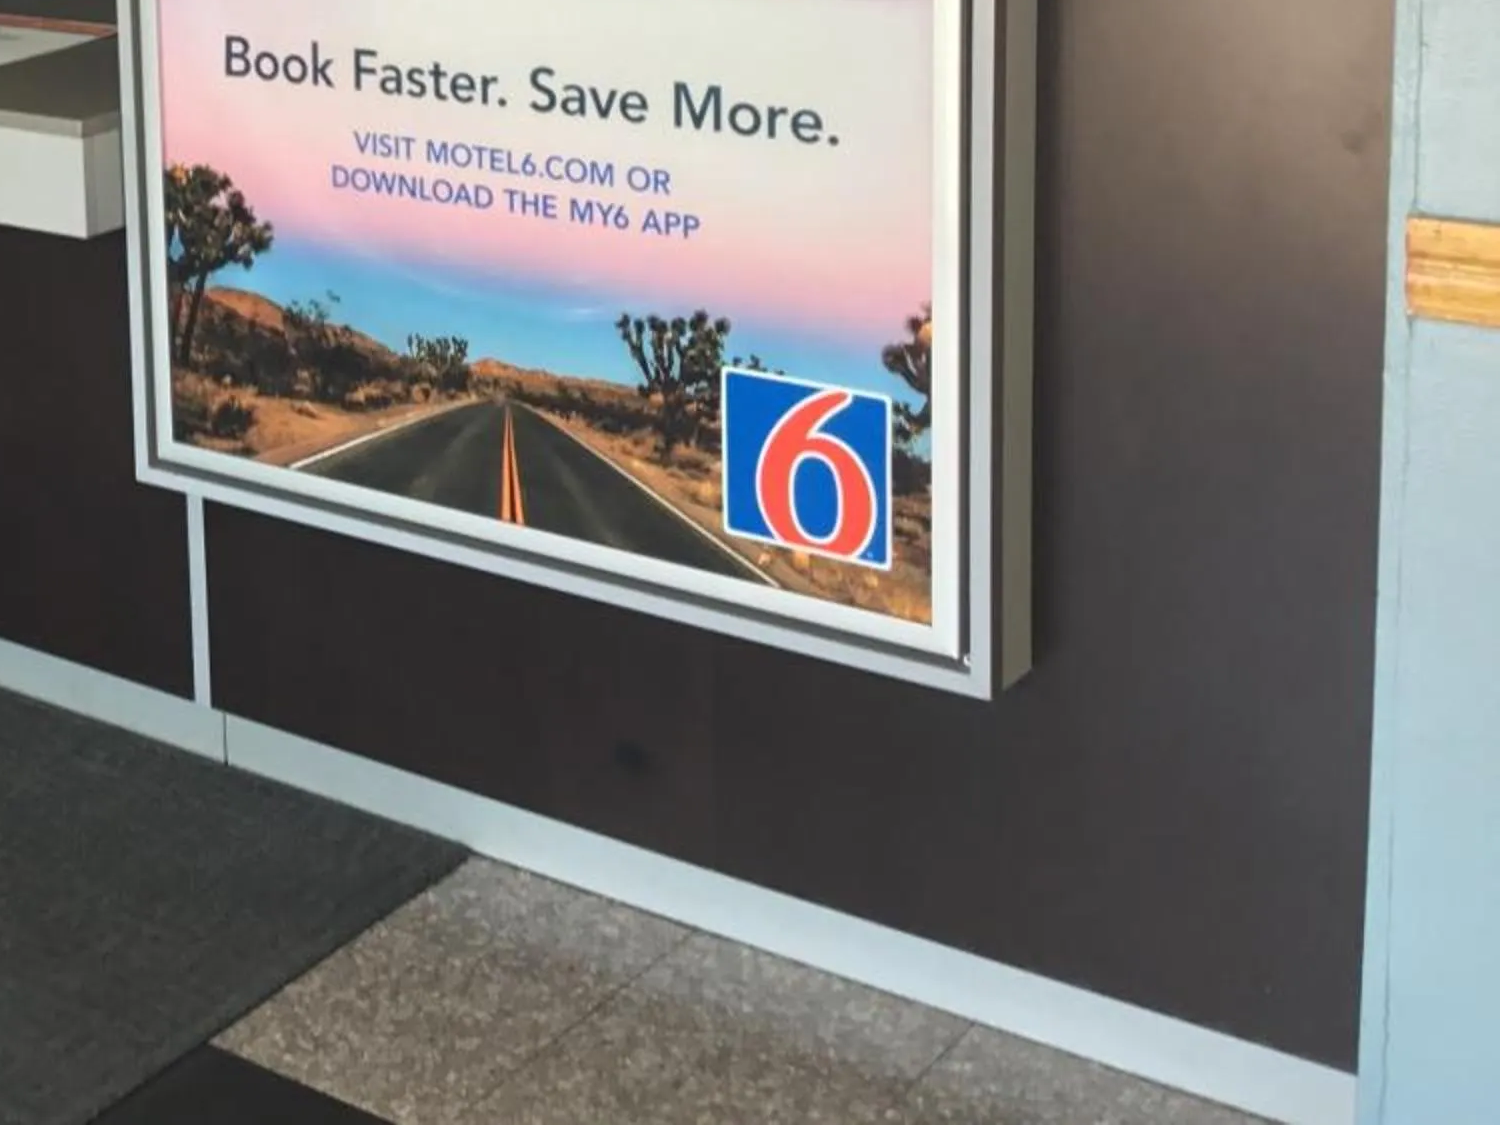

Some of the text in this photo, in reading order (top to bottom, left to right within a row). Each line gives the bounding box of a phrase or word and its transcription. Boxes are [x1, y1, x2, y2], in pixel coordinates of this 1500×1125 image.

[223, 35, 840, 147] Book Faster. Save More.
[330, 165, 700, 241] DOWNLOAD THE MY6 APP
[353, 131, 671, 195] VISIT MOTEL6.COM OR
[754, 388, 878, 561] 6
